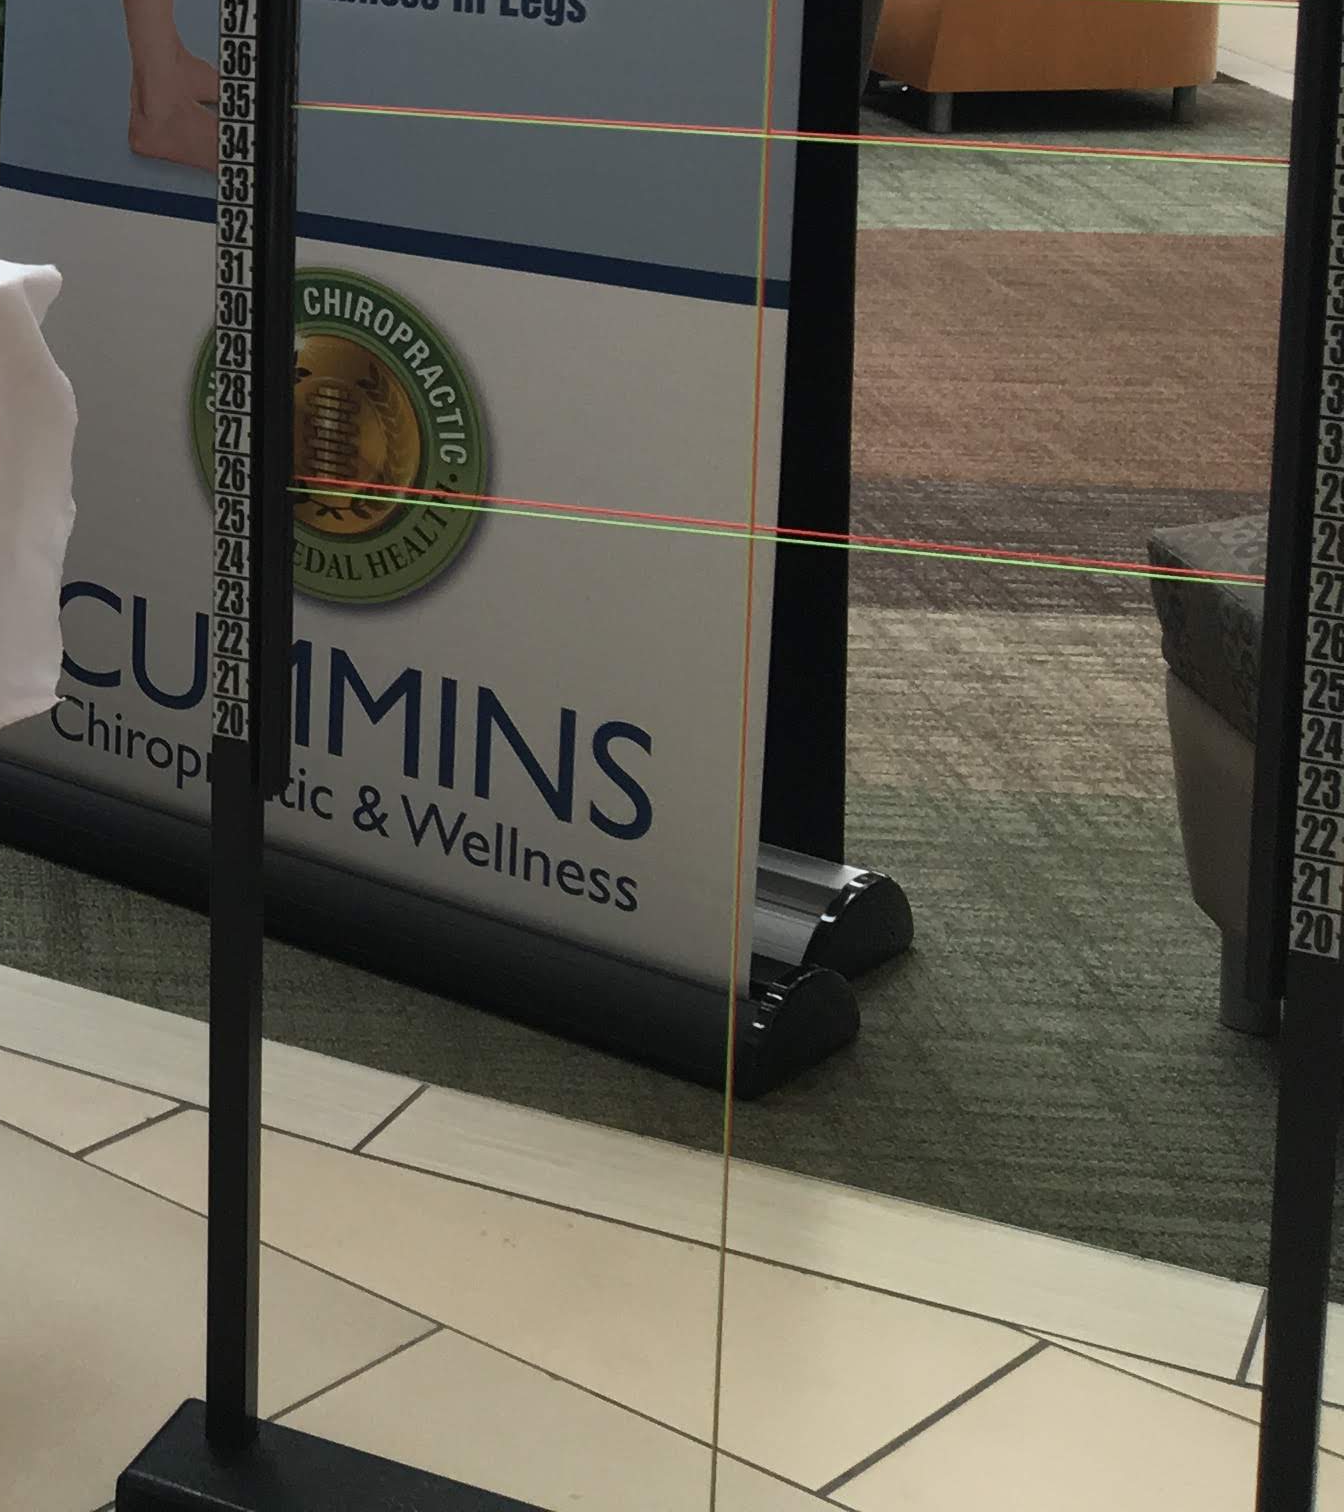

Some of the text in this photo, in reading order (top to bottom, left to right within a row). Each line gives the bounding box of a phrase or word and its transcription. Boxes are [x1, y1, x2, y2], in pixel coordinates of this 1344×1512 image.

[223, 40, 250, 75] 36
[223, 82, 250, 117] 35
[222, 124, 249, 159] 34
[222, 166, 248, 201] 33
[222, 208, 248, 243] 32
[221, 249, 247, 285] 31
[220, 291, 246, 327] 30
[220, 333, 245, 369] 29
[219, 374, 244, 409] 28
[303, 287, 467, 465] CHIROPRACTIC
[218, 414, 242, 450] 27
[218, 456, 242, 491] 26
[218, 497, 242, 532] 25
[218, 539, 242, 574] 24
[292, 545, 361, 581] EDAL
[217, 579, 242, 614] 23
[217, 620, 242, 655] 22
[217, 660, 242, 696] 21
[1308, 669, 1344, 712] 25
[217, 700, 242, 736] 20
[1306, 719, 1343, 760] 24
[50, 696, 638, 912] Chiroptic & Wellness
[1303, 767, 1341, 809] 23
[1301, 816, 1337, 858] 22
[1298, 865, 1331, 904] 21
[1295, 914, 1334, 954] 20
